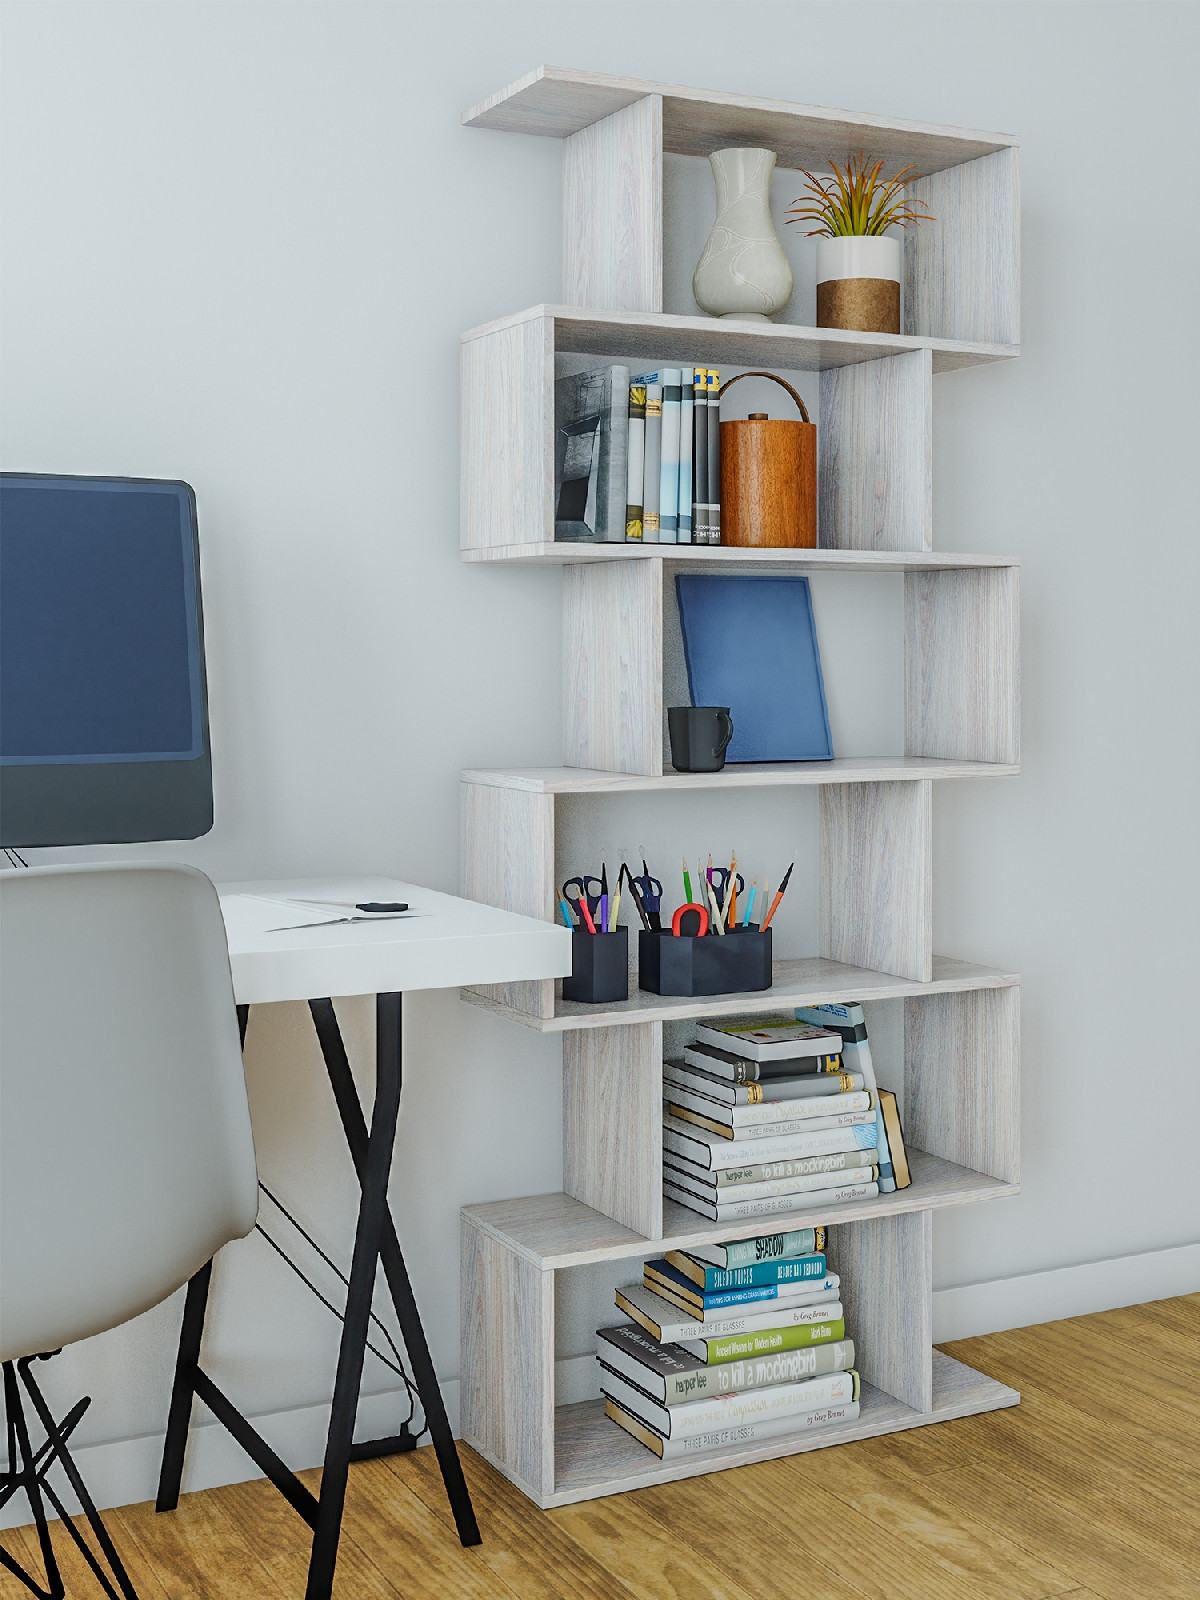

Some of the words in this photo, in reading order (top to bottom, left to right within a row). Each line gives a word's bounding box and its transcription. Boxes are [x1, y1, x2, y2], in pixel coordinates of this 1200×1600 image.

[761, 1166, 771, 1179] to
[772, 1163, 785, 1177] kill
[786, 1163, 793, 1176] a
[794, 1154, 846, 1175] mockingbird
[755, 1235, 784, 1260] SHADOW
[695, 1371, 707, 1389] lee
[718, 1368, 729, 1391] to
[731, 1360, 744, 1387] kill
[747, 1363, 754, 1386] a
[756, 1347, 817, 1384] mockingbird
[684, 1437, 702, 1450] THREE
